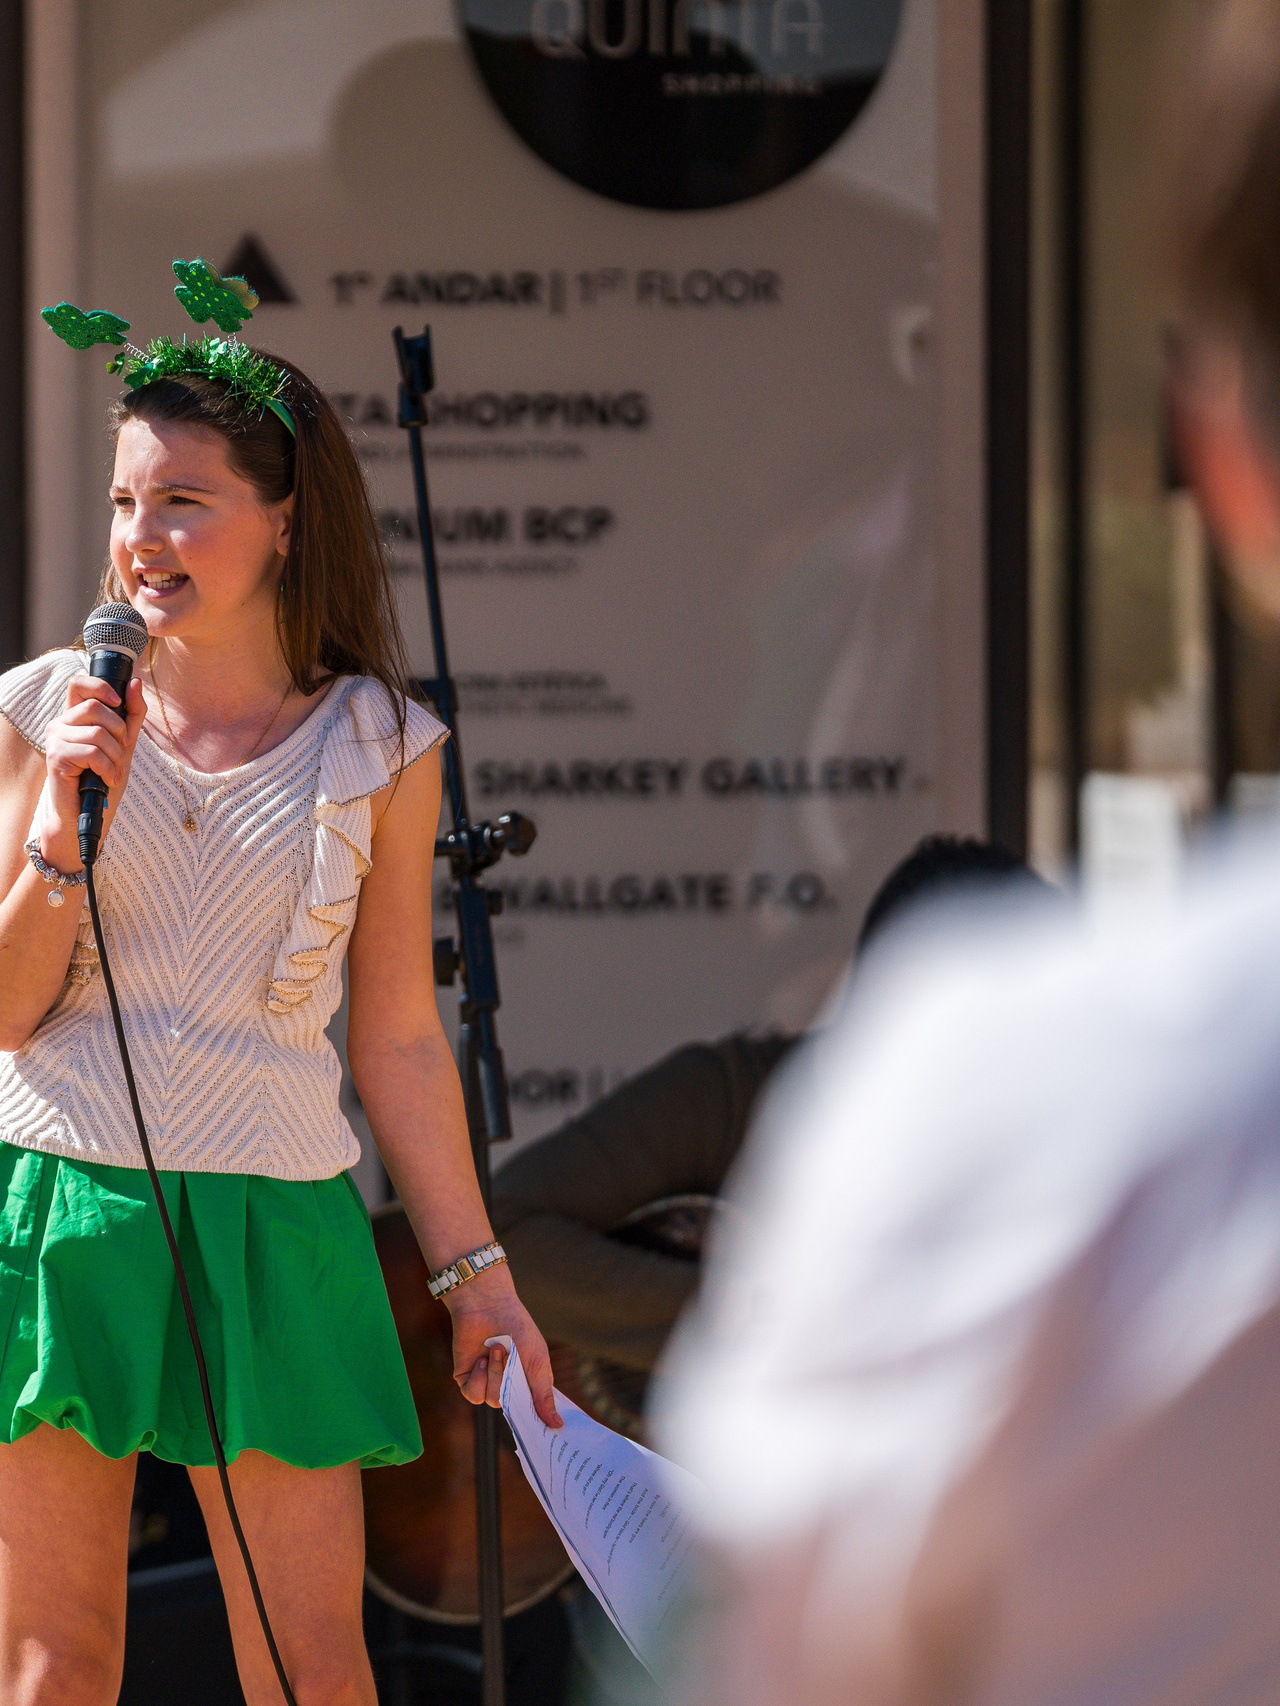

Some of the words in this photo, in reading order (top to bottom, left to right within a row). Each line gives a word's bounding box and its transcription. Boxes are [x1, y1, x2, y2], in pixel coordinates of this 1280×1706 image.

[380, 270, 542, 305] ANDAR
[637, 267, 781, 305] FLOOR
[424, 391, 649, 429] HOPPING
[524, 506, 613, 544] BCP
[475, 758, 685, 798] SHARKEY
[701, 757, 907, 796] GALLERY
